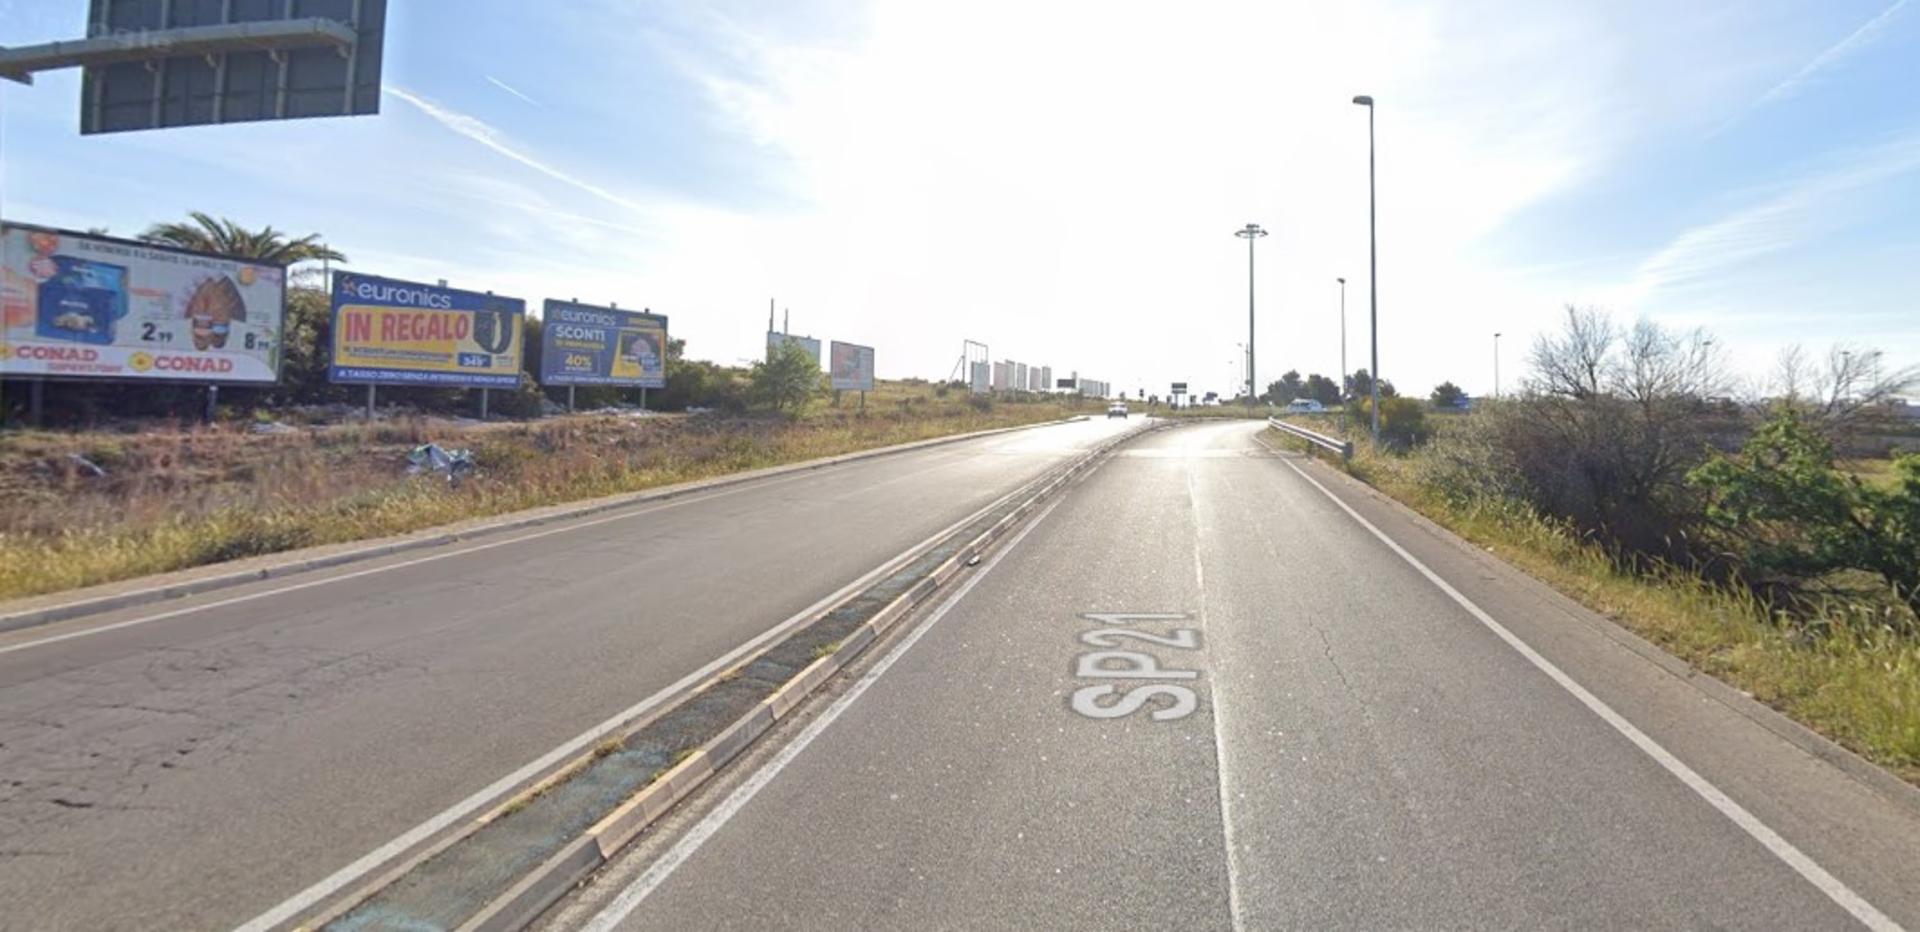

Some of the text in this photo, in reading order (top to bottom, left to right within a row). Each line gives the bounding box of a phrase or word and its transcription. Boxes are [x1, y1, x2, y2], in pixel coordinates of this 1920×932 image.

[358, 282, 451, 308] euronics
[561, 309, 616, 326] euronics
[345, 312, 468, 341] IN REGALO
[555, 326, 605, 341] SCONTI
[16, 345, 98, 361] CONAD
[565, 352, 592, 366] 40%
[155, 356, 232, 372] CONAD
